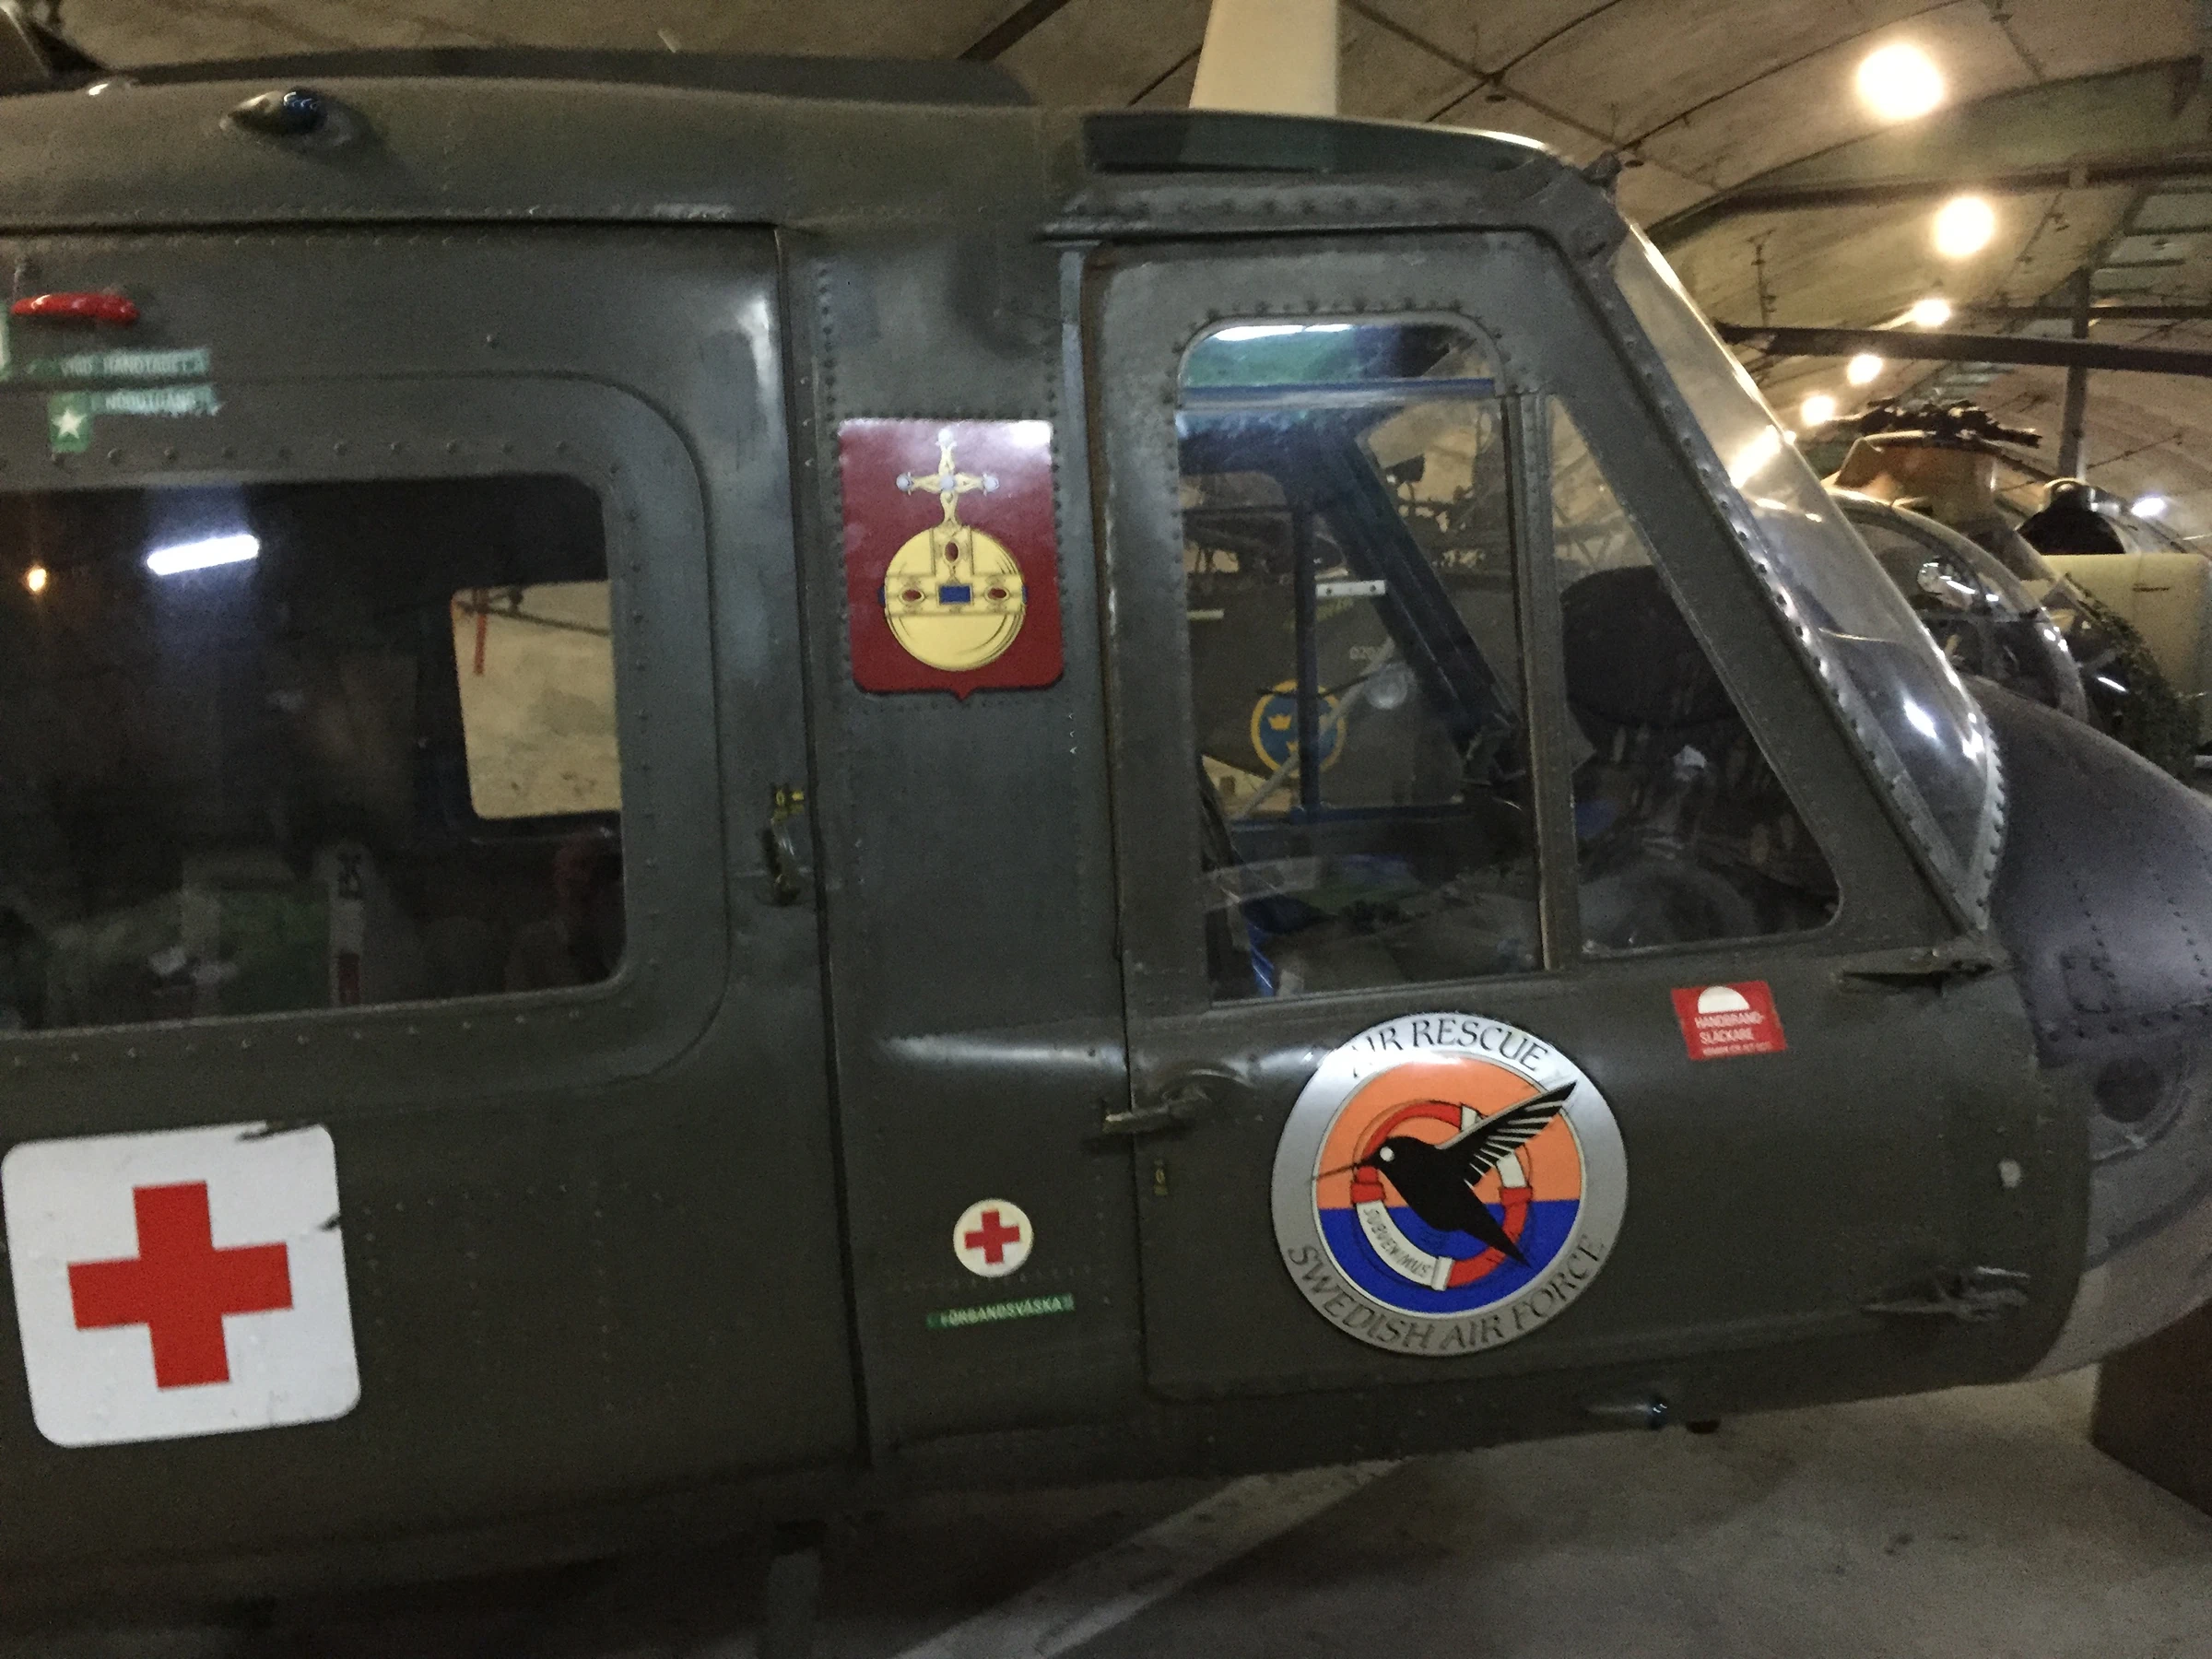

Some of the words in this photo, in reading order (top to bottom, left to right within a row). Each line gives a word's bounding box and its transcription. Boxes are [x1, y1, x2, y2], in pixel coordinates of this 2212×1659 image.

[1412, 1018, 1548, 1072] RESCUE
[1289, 1244, 1436, 1350] SWEDISH
[1440, 1314, 1512, 1352] AIR
[1510, 1232, 1607, 1331] FORCE
